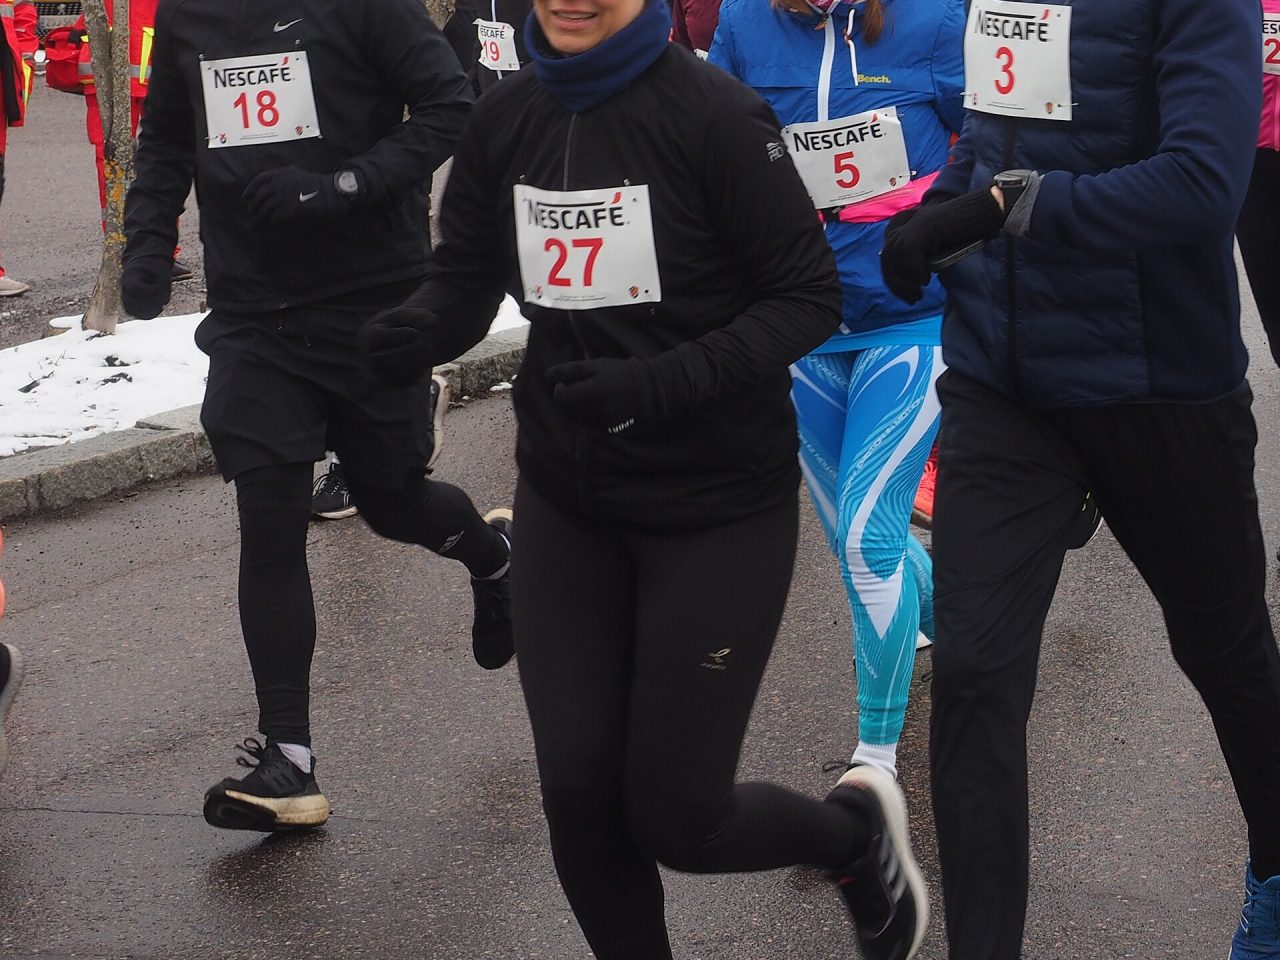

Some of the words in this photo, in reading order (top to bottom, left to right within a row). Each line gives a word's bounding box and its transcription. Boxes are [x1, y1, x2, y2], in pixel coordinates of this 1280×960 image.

[974, 9, 1049, 42] NESCAFÉ
[483, 40, 500, 61] 19
[214, 56, 291, 88] NESCAFÉ
[994, 46, 1015, 95] 3
[233, 90, 279, 128] 18
[793, 114, 883, 152] NESCAFÉ
[833, 151, 860, 188] 5
[527, 192, 624, 229] NESCAFÉ
[544, 238, 603, 287] 27
